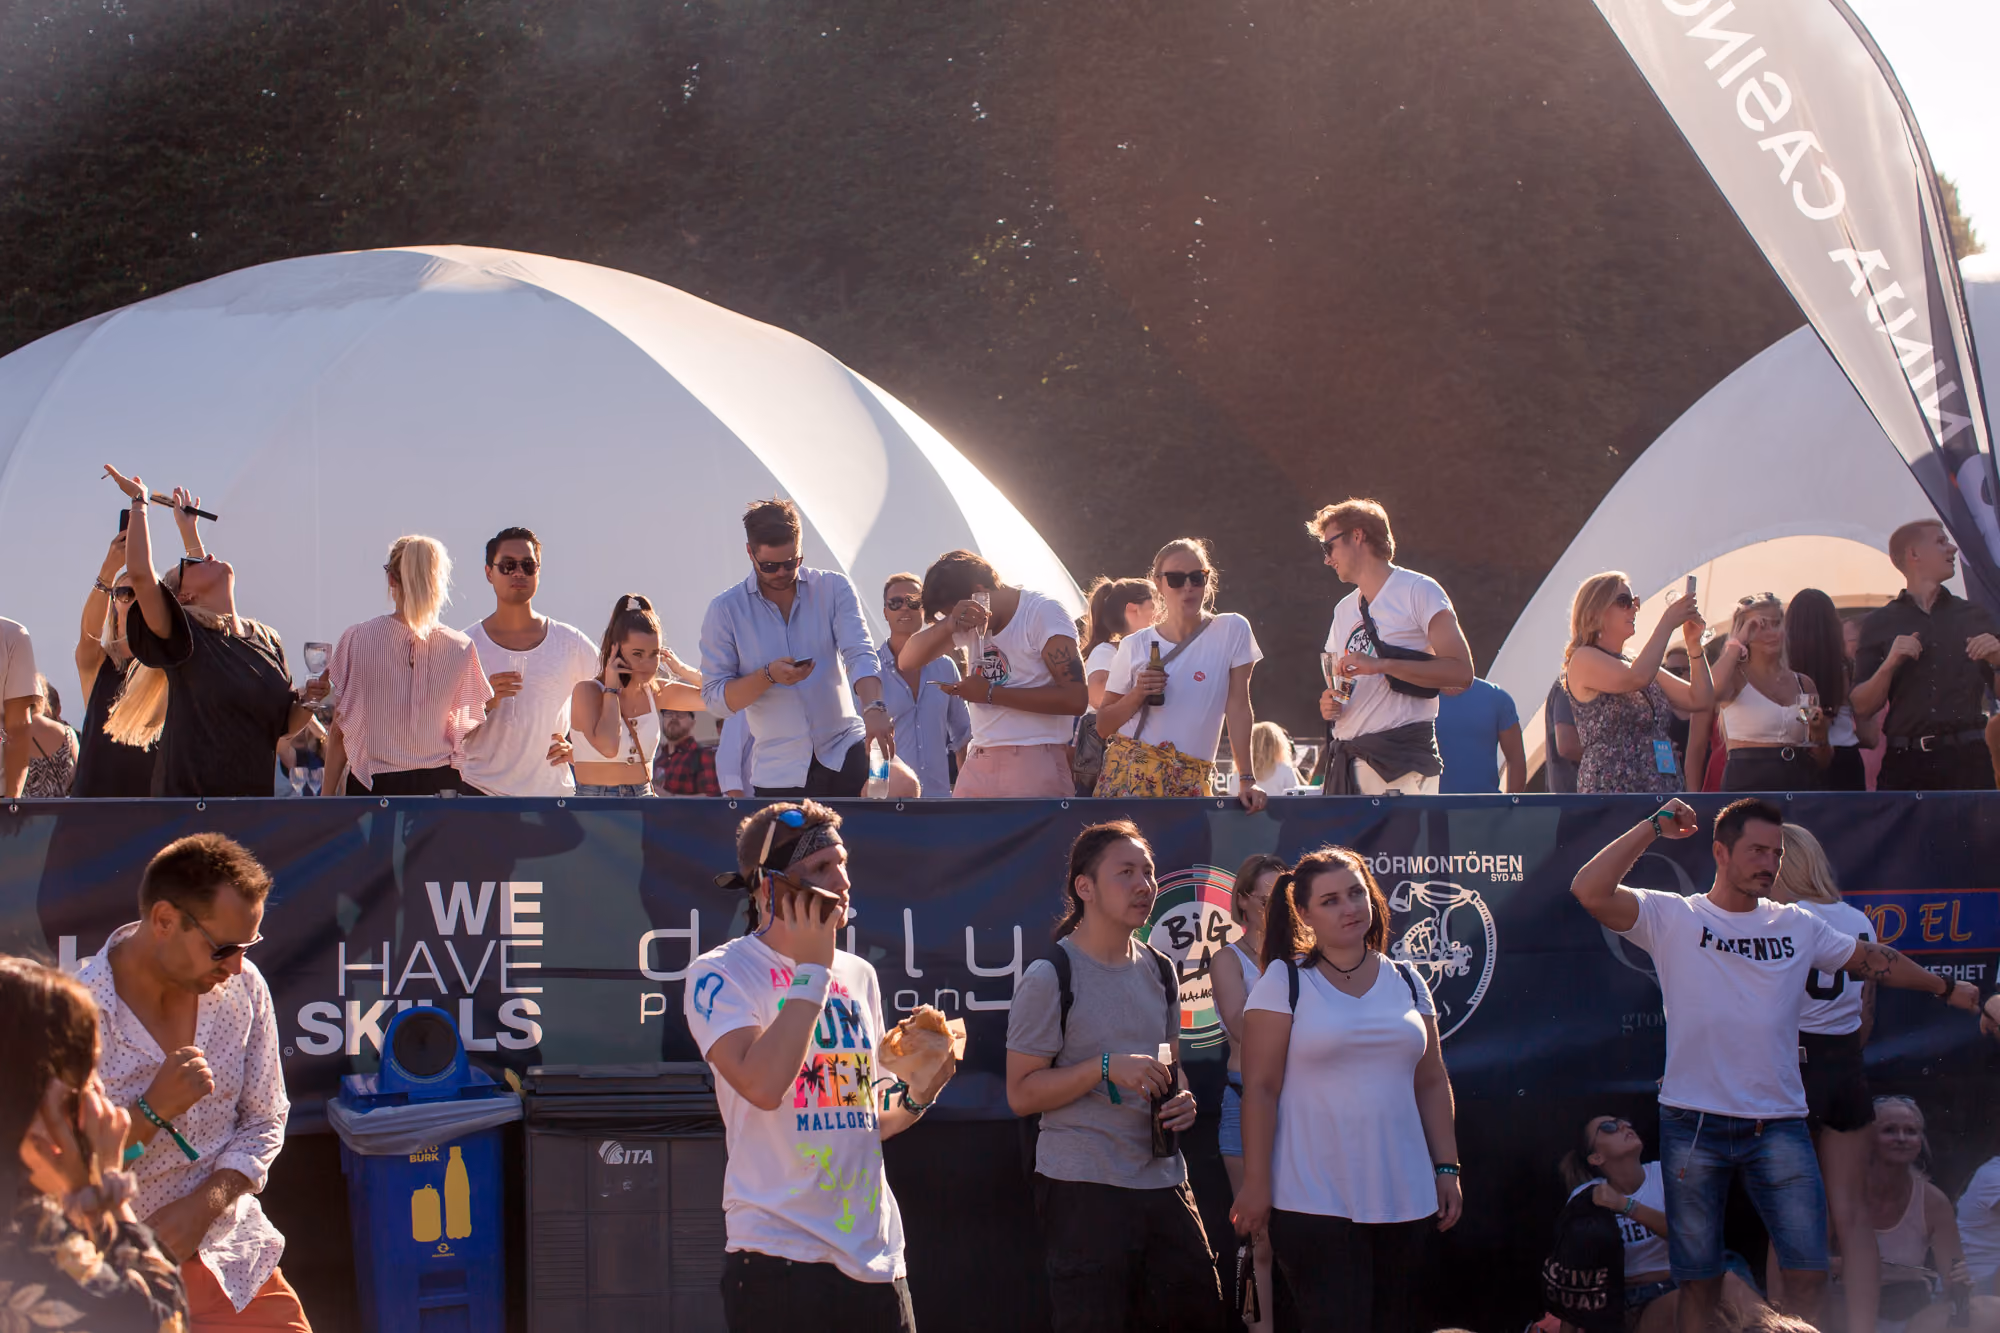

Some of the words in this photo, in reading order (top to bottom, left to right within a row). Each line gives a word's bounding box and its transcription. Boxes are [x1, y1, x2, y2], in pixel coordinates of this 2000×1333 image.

[1491, 874, 1508, 882] SYD
[1511, 873, 1524, 881] AB
[424, 881, 544, 935] WE
[1920, 899, 1973, 942] EL
[338, 939, 544, 997] HAVE
[638, 908, 1023, 1010] dily
[295, 998, 543, 1056] SKLS
[409, 1152, 439, 1163] BURK
[611, 1148, 653, 1165] SITA
